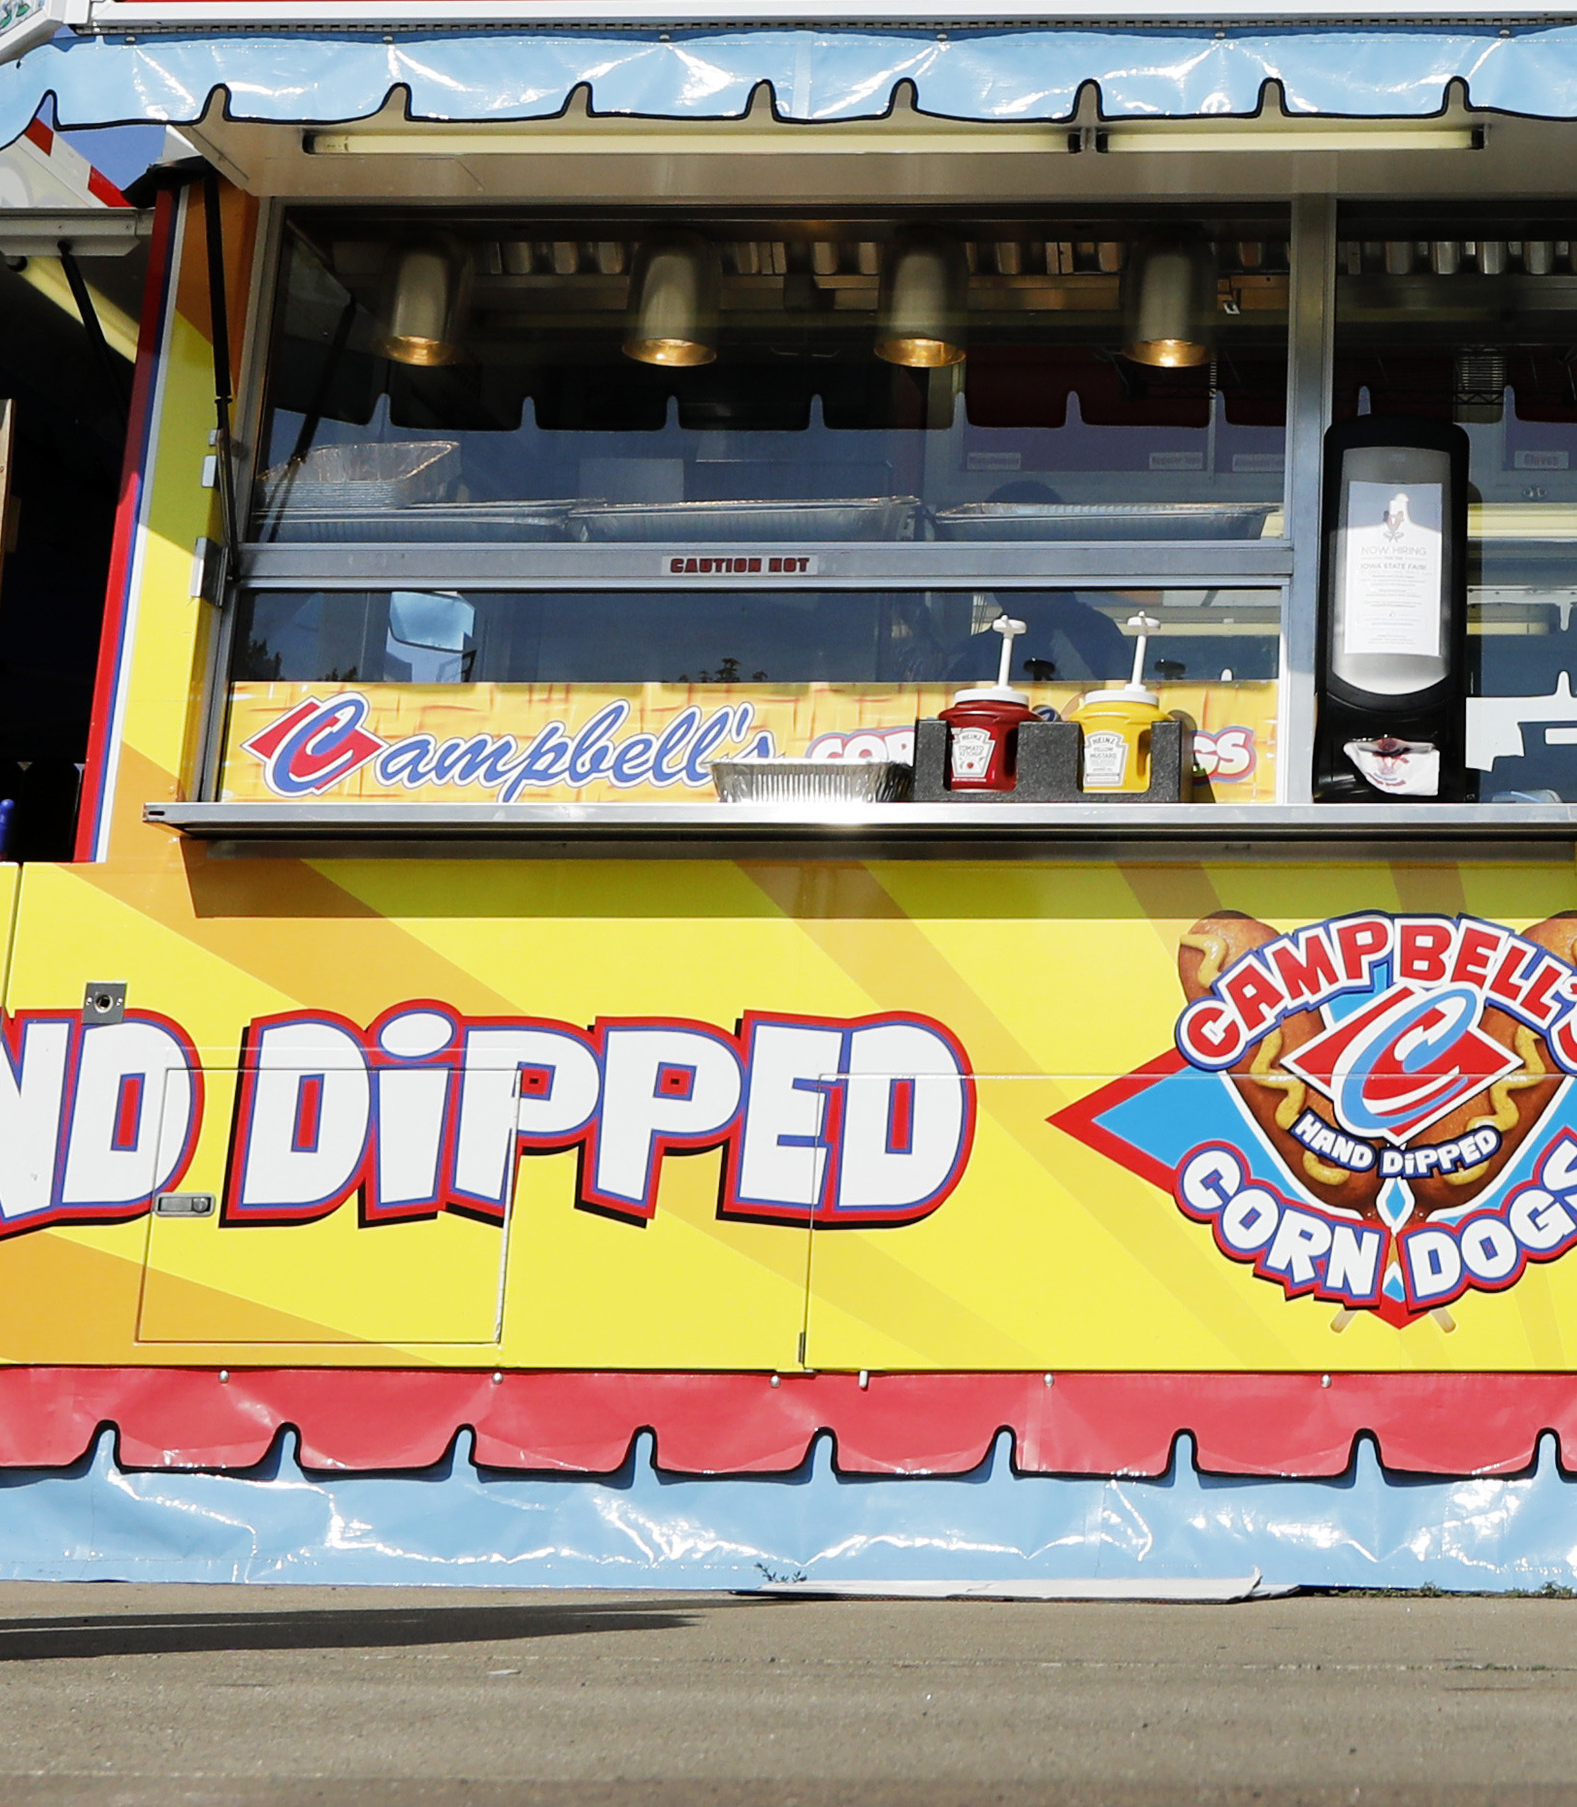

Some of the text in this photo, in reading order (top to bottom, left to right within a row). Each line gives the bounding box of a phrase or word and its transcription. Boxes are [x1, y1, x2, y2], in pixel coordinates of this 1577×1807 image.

[670, 557, 811, 574] CAUTION HOT
[1092, 736, 1116, 745] HEINZ
[1290, 1109, 1379, 1174] HAND
[1174, 1139, 1391, 1309] CORN
